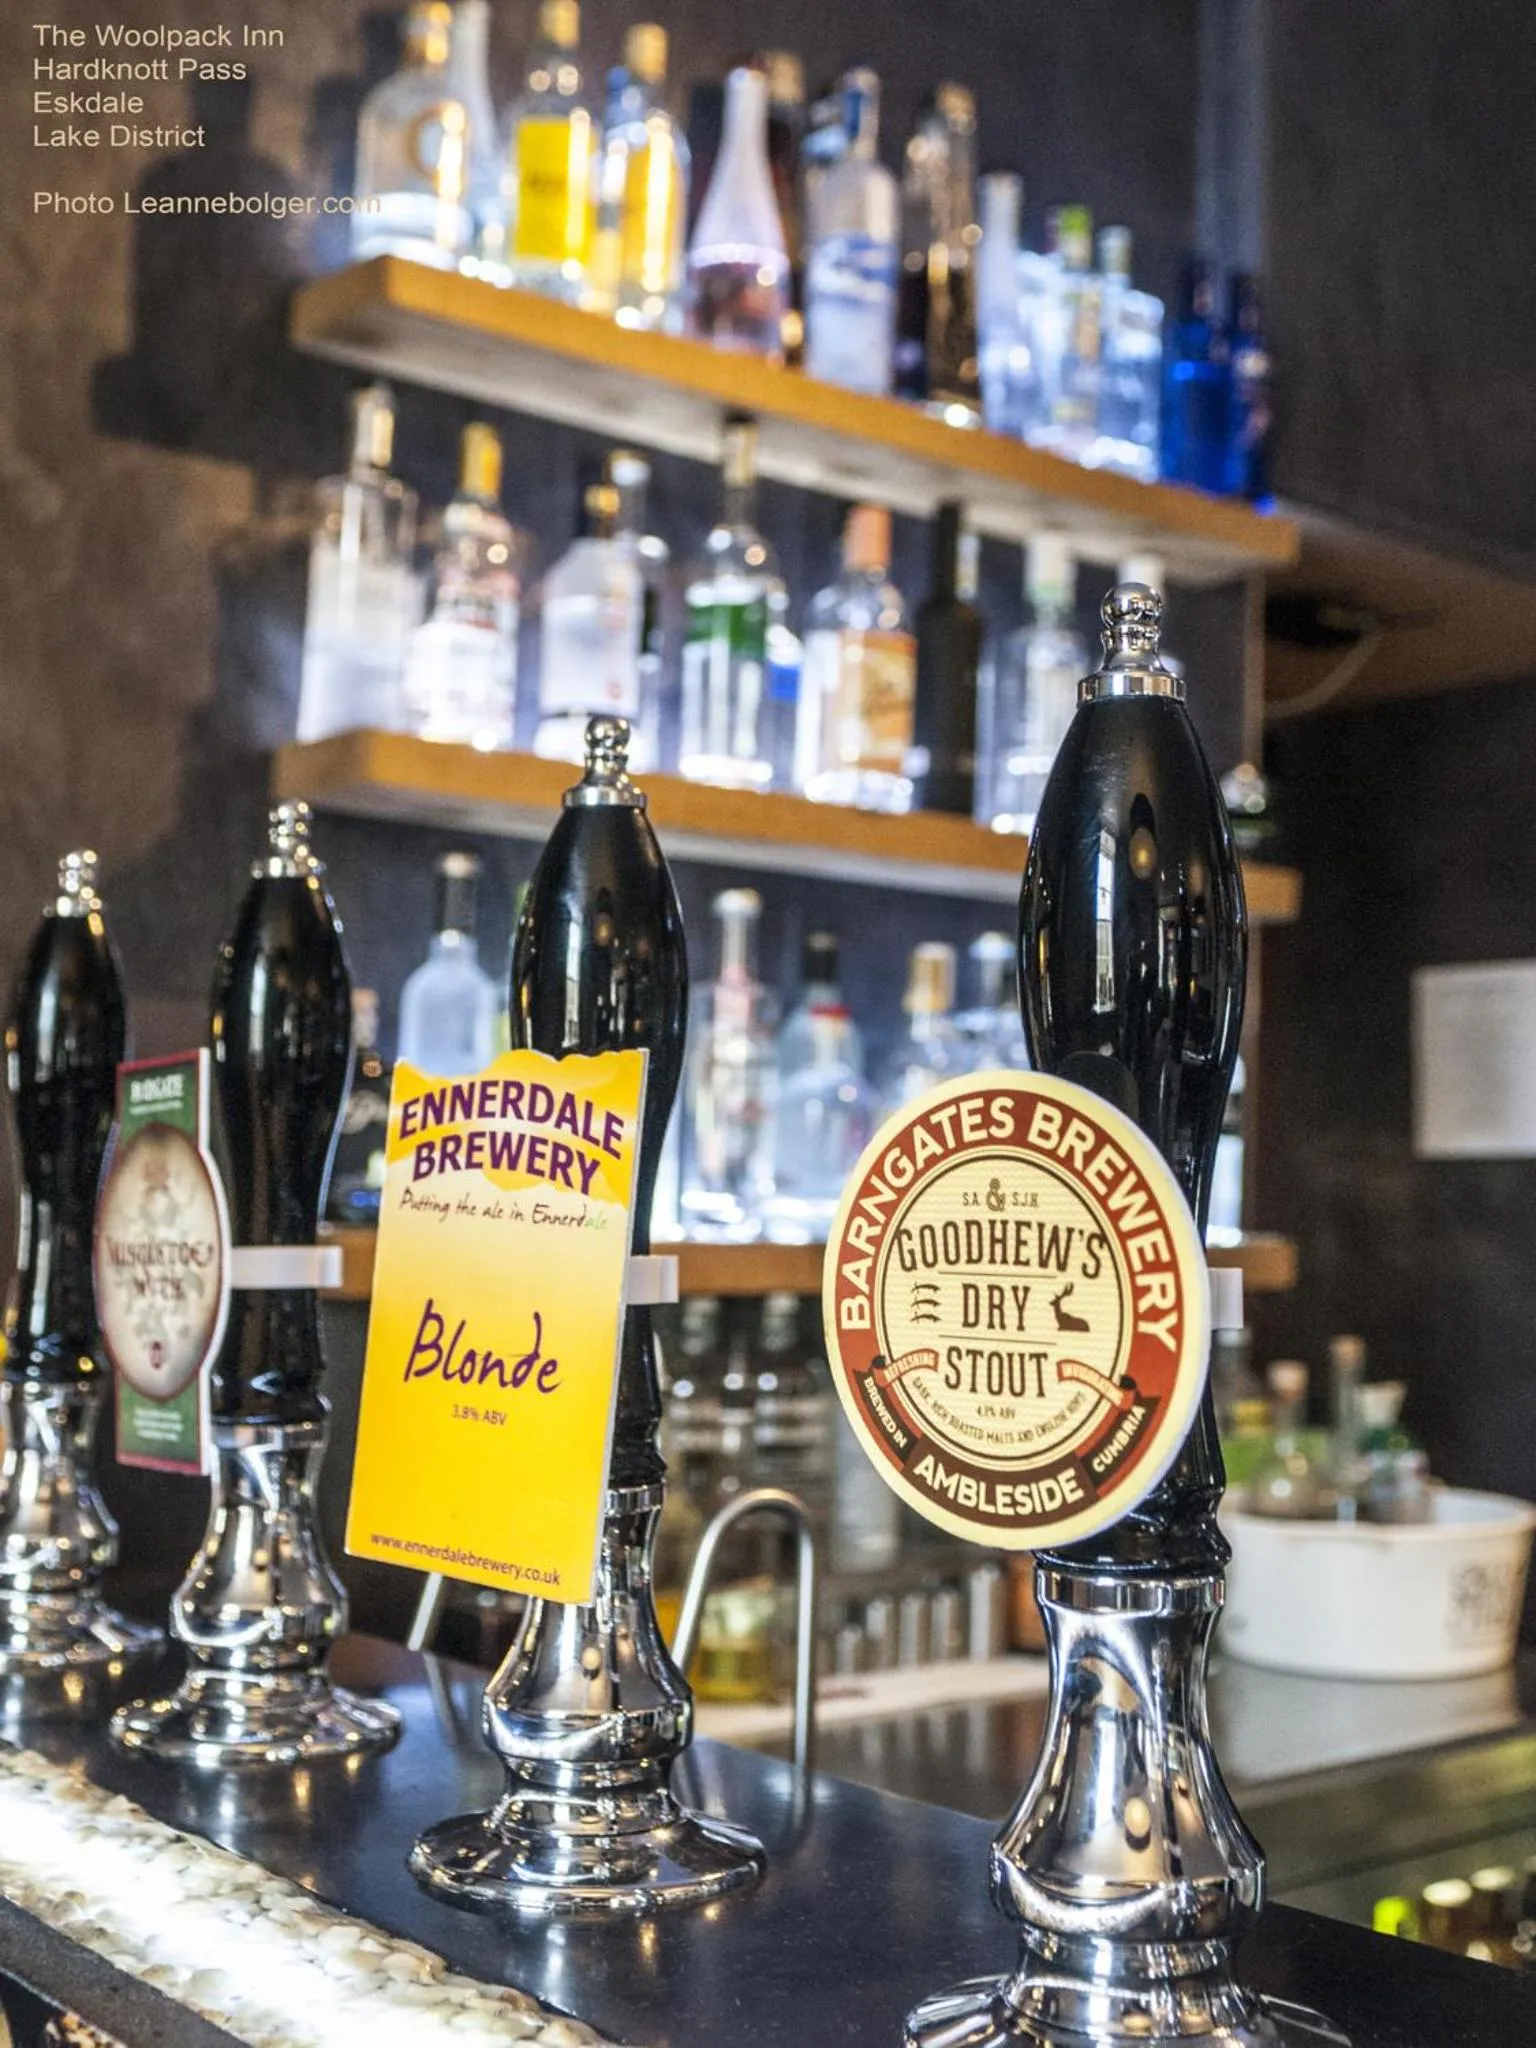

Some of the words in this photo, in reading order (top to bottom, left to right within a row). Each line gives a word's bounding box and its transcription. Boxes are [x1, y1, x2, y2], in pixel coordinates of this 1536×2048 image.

[400, 1080, 624, 1160] ENNERDALE
[412, 1131, 600, 1196] BREWERY
[400, 1187, 450, 1222] Putting
[456, 1193, 475, 1215] the
[482, 1201, 503, 1219] ale
[510, 1203, 524, 1221] in
[532, 1203, 608, 1230] Ennerdale
[841, 1096, 1015, 1330] BARNGATES
[1027, 1101, 1177, 1352] BREWERY
[986, 1177, 1005, 1212] &
[895, 1219, 1109, 1280] GOODHEW'S
[962, 1283, 1031, 1332] DRY
[404, 1298, 563, 1394] Blonde
[944, 1345, 1048, 1398] STOUT
[451, 1404, 479, 1422] 3.8%
[482, 1409, 508, 1426] ABV
[864, 1376, 896, 1432] BREWED
[893, 1430, 907, 1448] IN
[1092, 1404, 1146, 1473] CUMBRIA
[914, 1454, 1084, 1515] AMBLESIDE
[370, 1532, 560, 1585] www.ennerdalebrewery.co.uk
